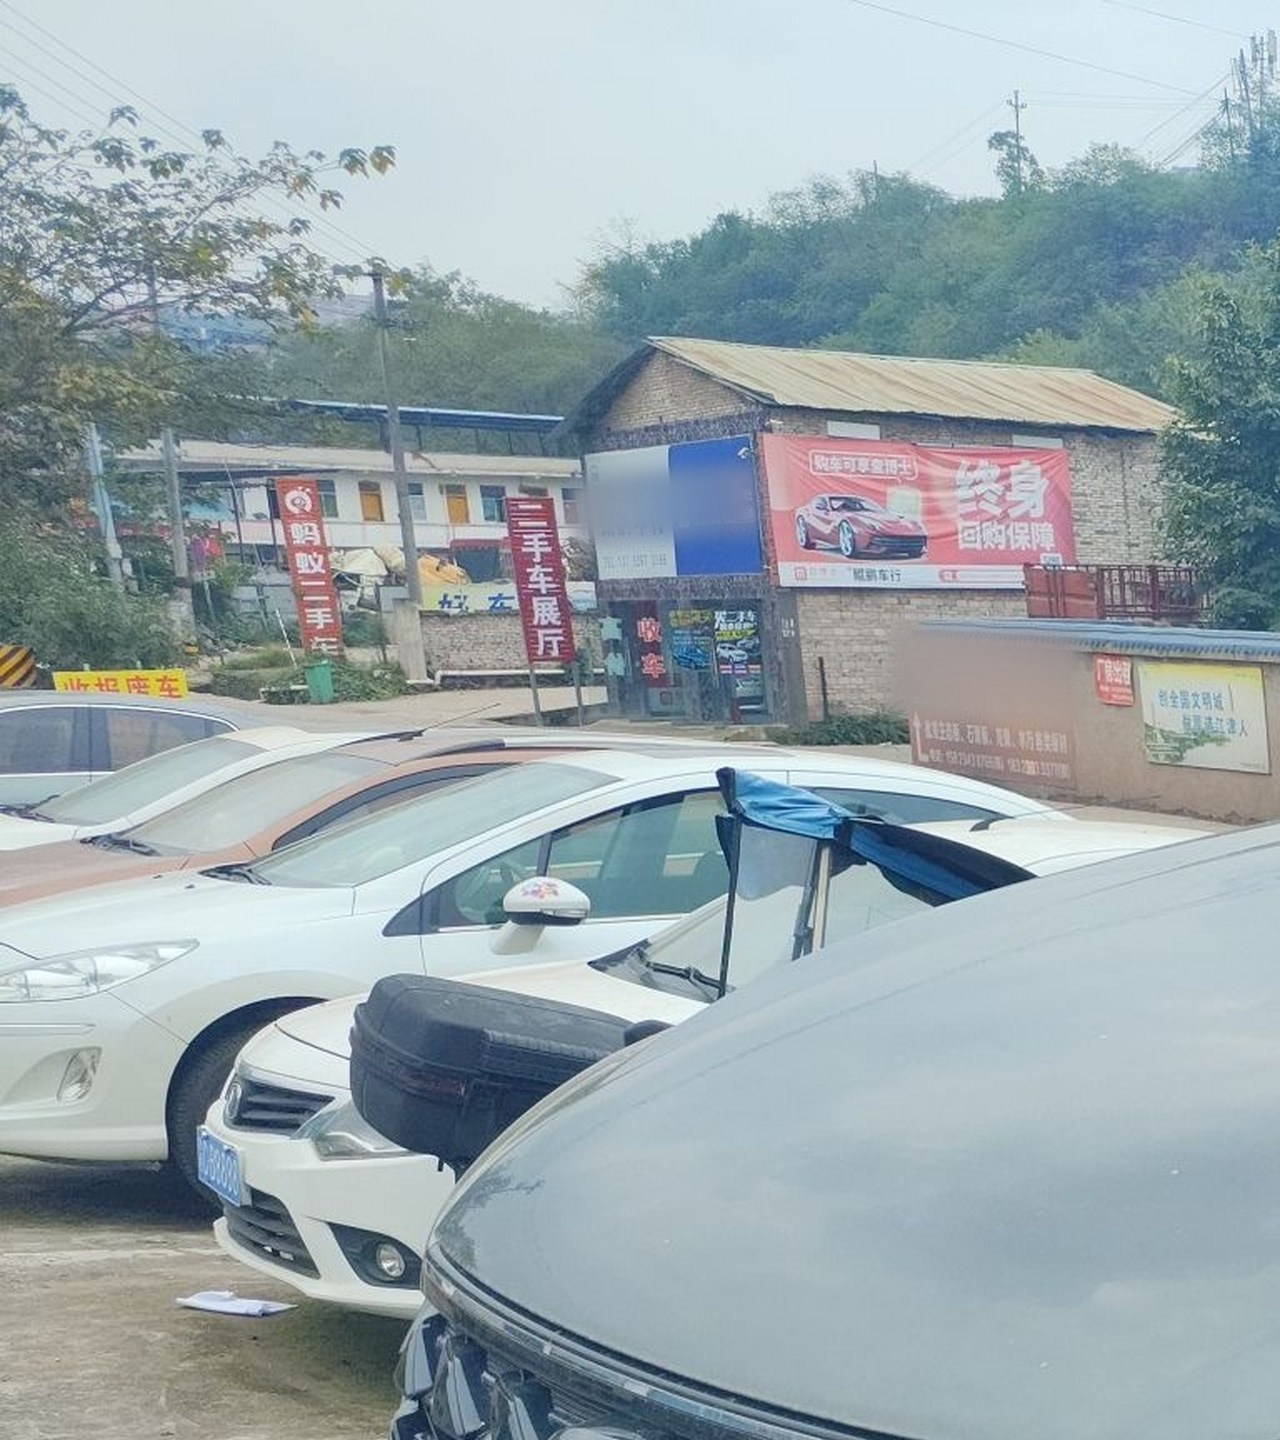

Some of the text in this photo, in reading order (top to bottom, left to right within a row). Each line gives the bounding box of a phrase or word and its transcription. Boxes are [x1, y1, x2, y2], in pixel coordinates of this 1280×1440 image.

[955, 459, 1049, 518] 终身
[958, 520, 1055, 551] 回购保障
[517, 504, 566, 658] 二手车展厅
[637, 617, 667, 679] 收车
